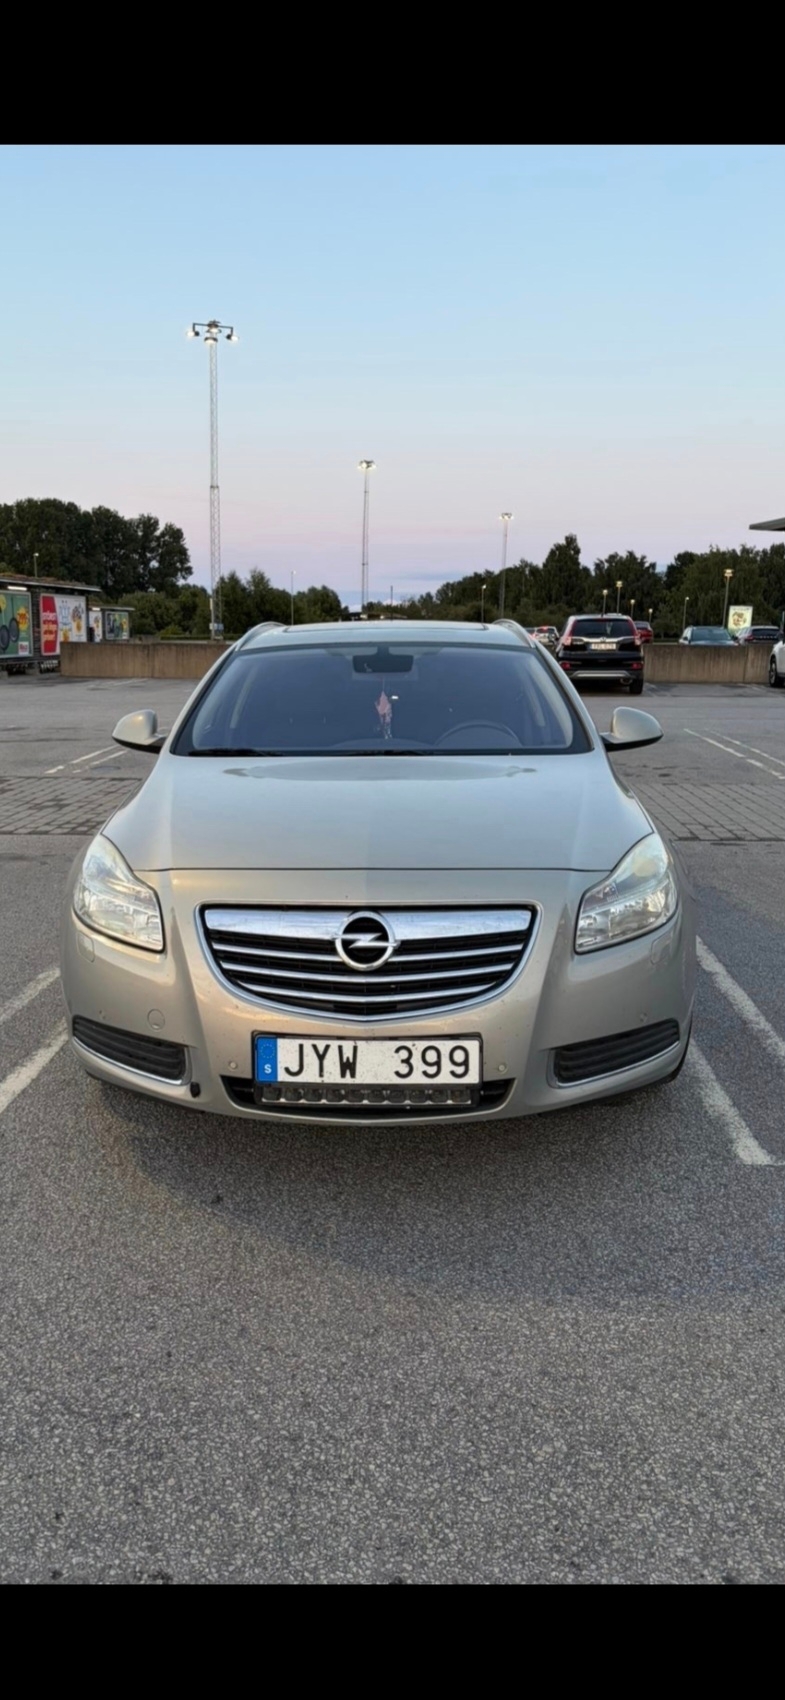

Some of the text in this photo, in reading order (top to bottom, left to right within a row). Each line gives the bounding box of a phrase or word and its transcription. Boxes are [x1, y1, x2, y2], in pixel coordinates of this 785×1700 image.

[264, 1063, 272, 1074] S
[284, 1043, 470, 1079] JYW 399
